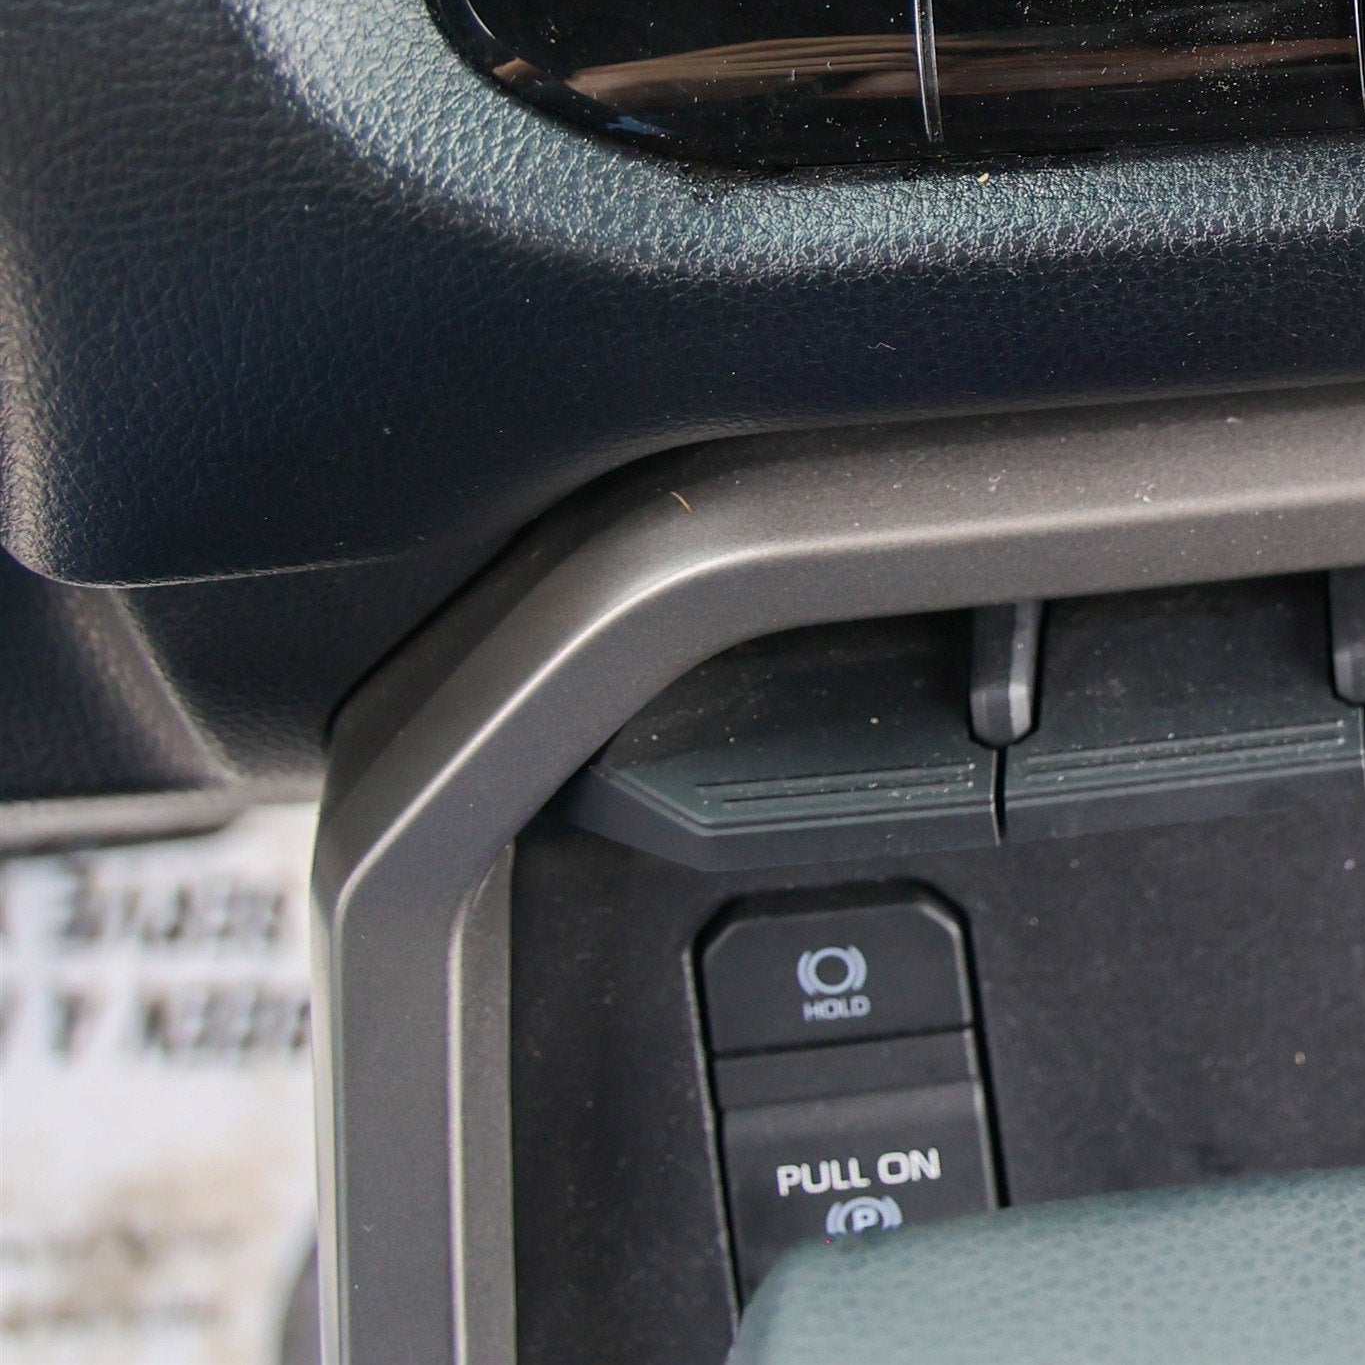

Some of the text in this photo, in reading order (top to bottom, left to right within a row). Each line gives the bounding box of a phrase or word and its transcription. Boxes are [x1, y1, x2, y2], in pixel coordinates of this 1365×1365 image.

[803, 995, 871, 1021] HOLD
[776, 1147, 942, 1197] PULL ON
